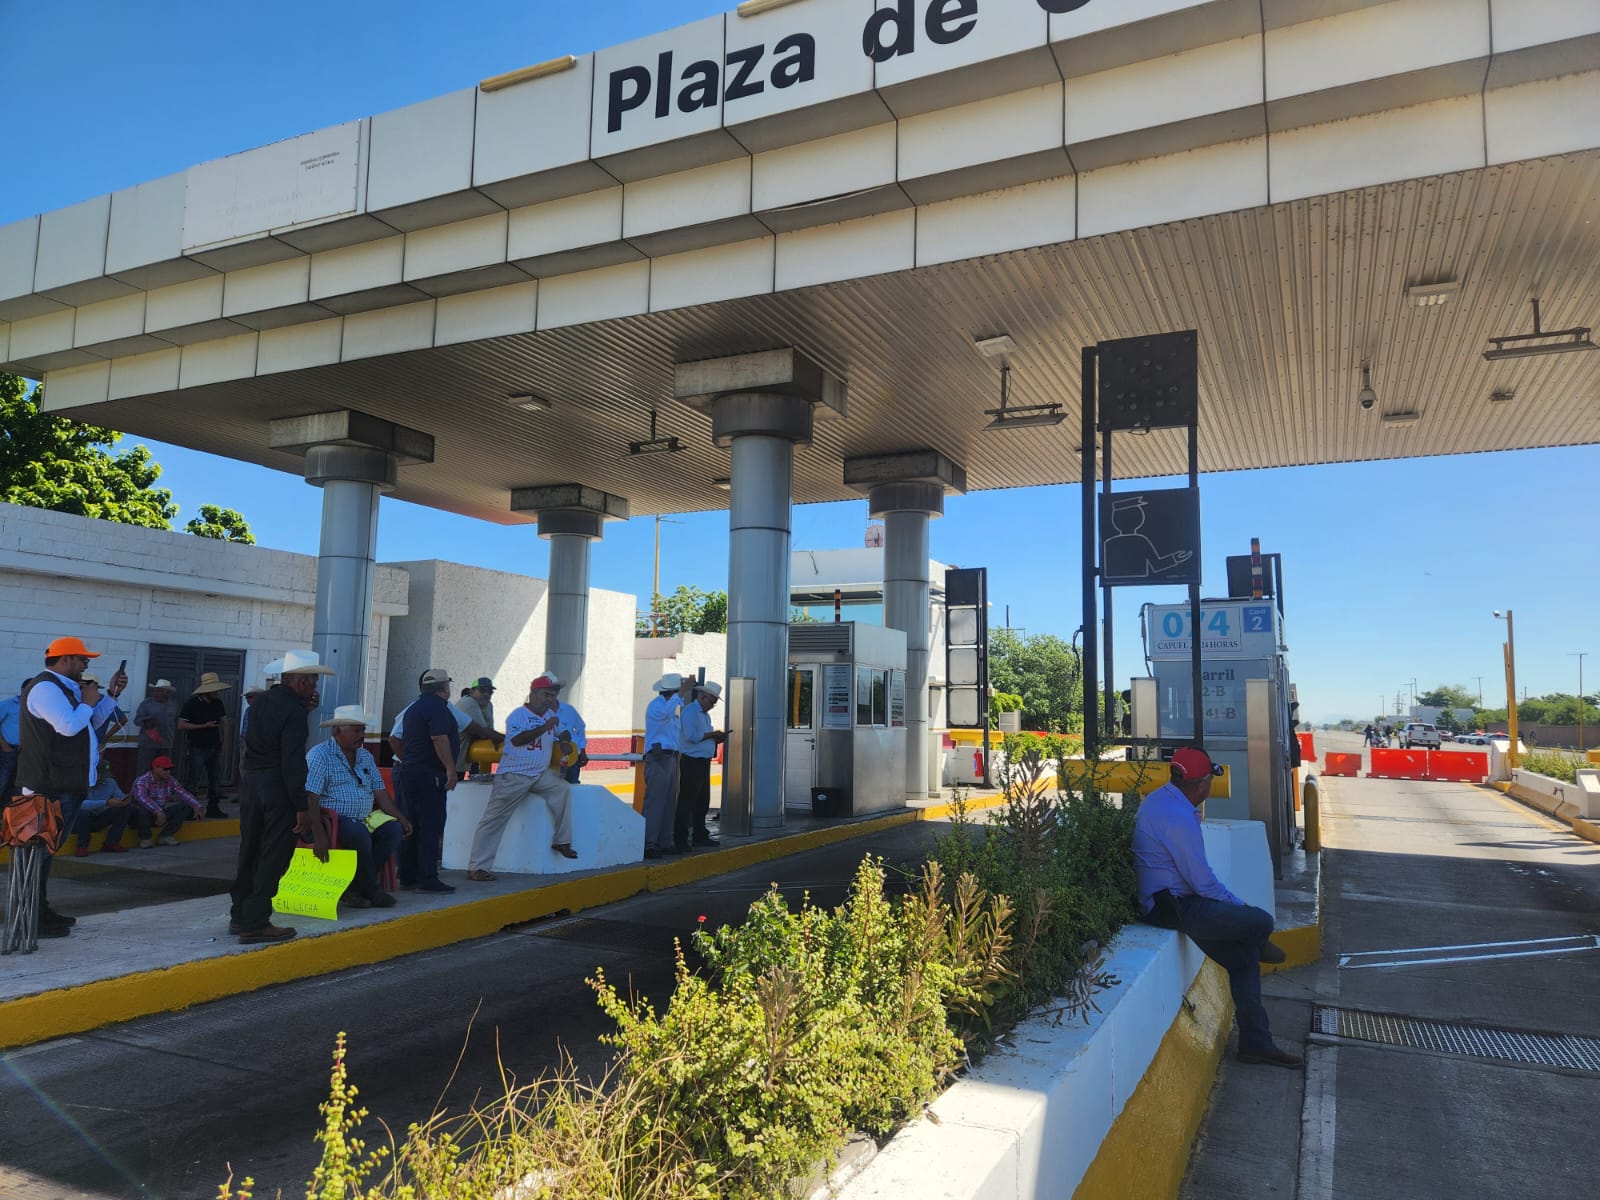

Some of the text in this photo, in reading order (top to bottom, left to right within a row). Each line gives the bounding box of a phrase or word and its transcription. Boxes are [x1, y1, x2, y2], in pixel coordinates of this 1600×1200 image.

[607, 0, 979, 134] Plaza de
[1252, 616, 1263, 630] 2
[1209, 640, 1239, 649] HORAS
[1202, 669, 1235, 681] arril
